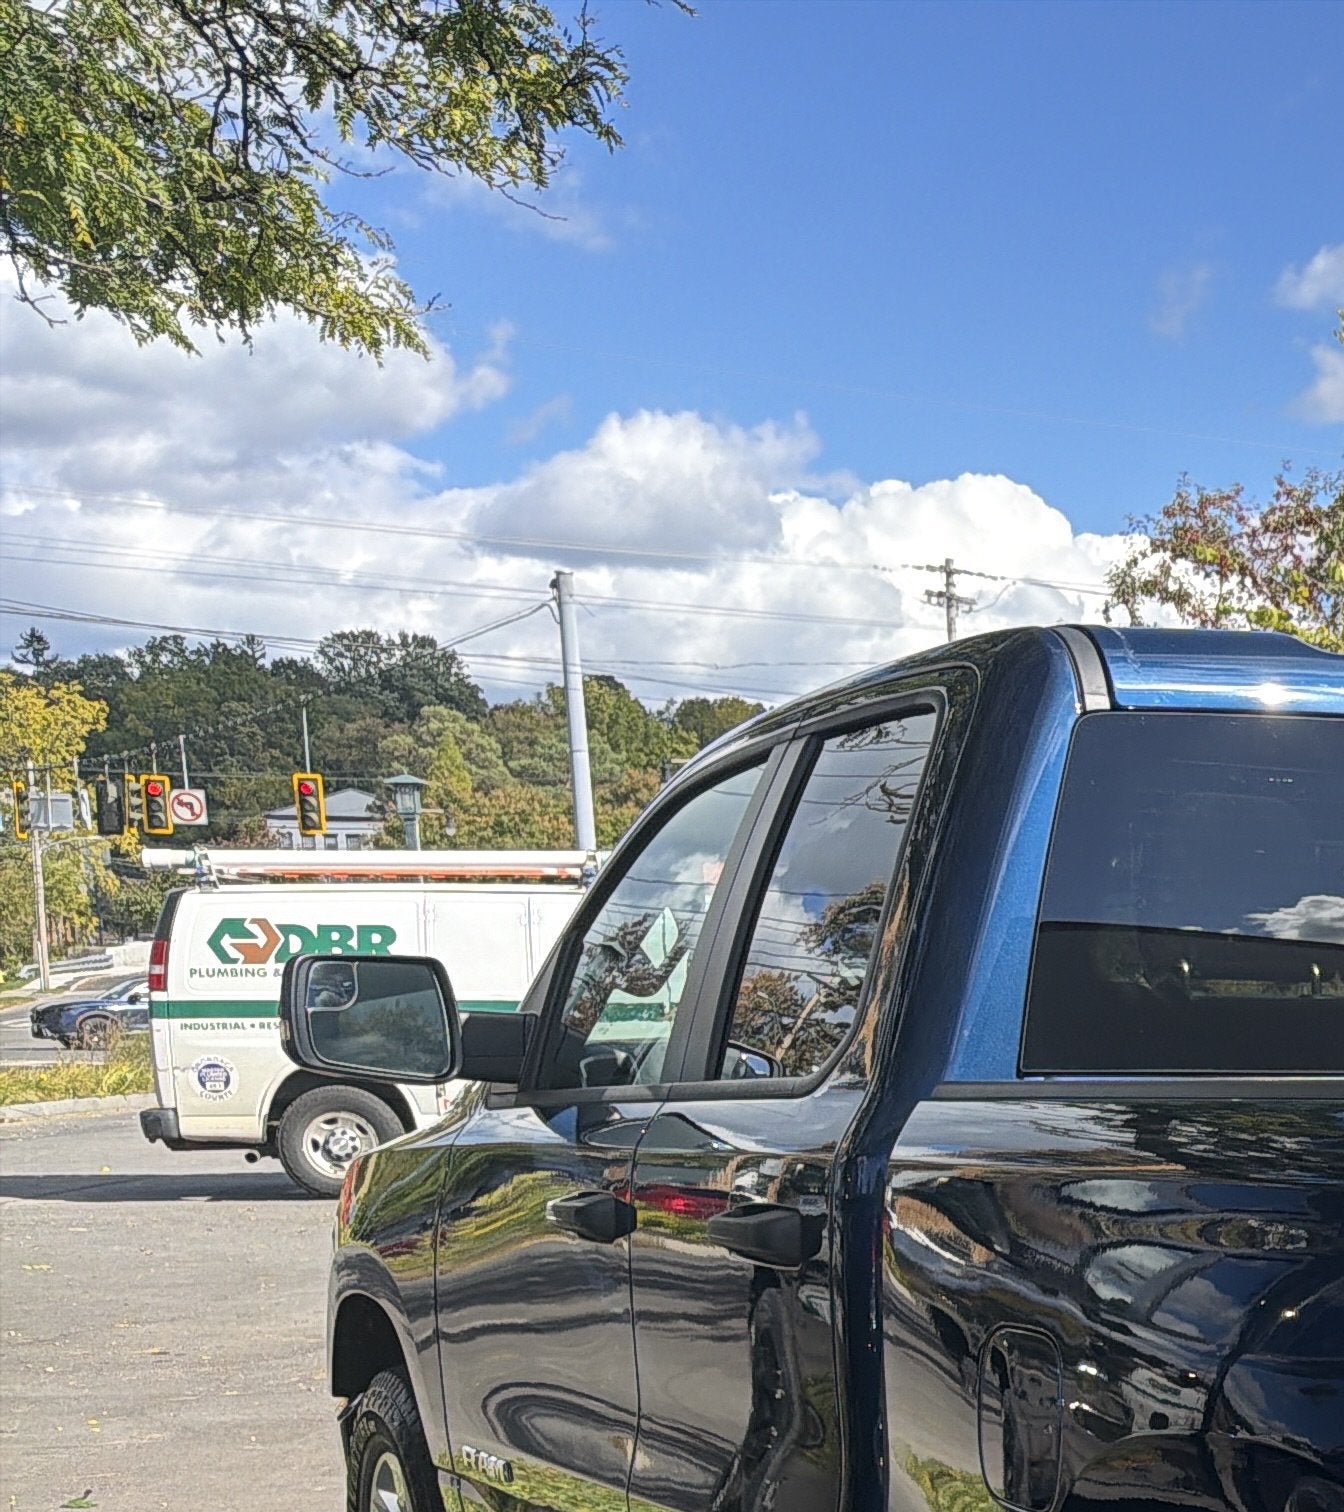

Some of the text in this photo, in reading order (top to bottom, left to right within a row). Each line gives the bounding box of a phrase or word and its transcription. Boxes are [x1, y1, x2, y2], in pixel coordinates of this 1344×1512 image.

[275, 924, 397, 963] DBR
[189, 967, 282, 979] PLUMBING &
[179, 1021, 247, 1031] INDUSTRIAL
